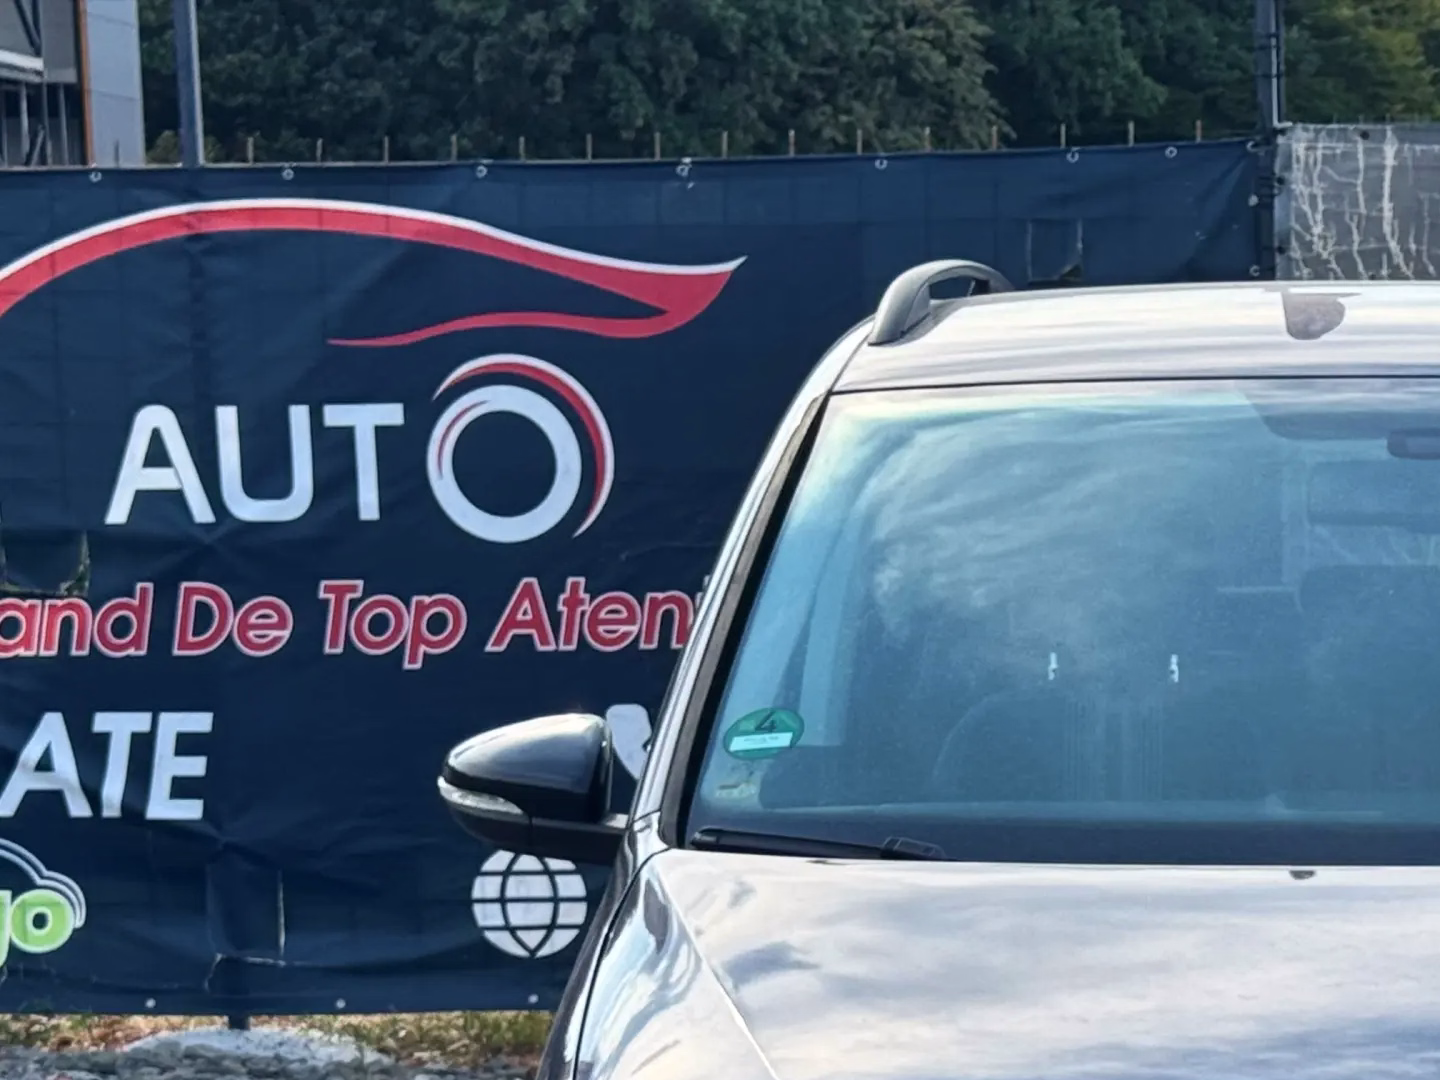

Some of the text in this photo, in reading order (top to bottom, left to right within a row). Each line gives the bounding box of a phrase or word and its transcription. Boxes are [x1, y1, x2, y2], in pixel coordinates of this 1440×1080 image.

[105, 384, 584, 543] AUTO
[172, 581, 293, 657] De
[319, 580, 468, 669] Top
[485, 575, 710, 652] Aten
[0, 712, 214, 820] ATE
